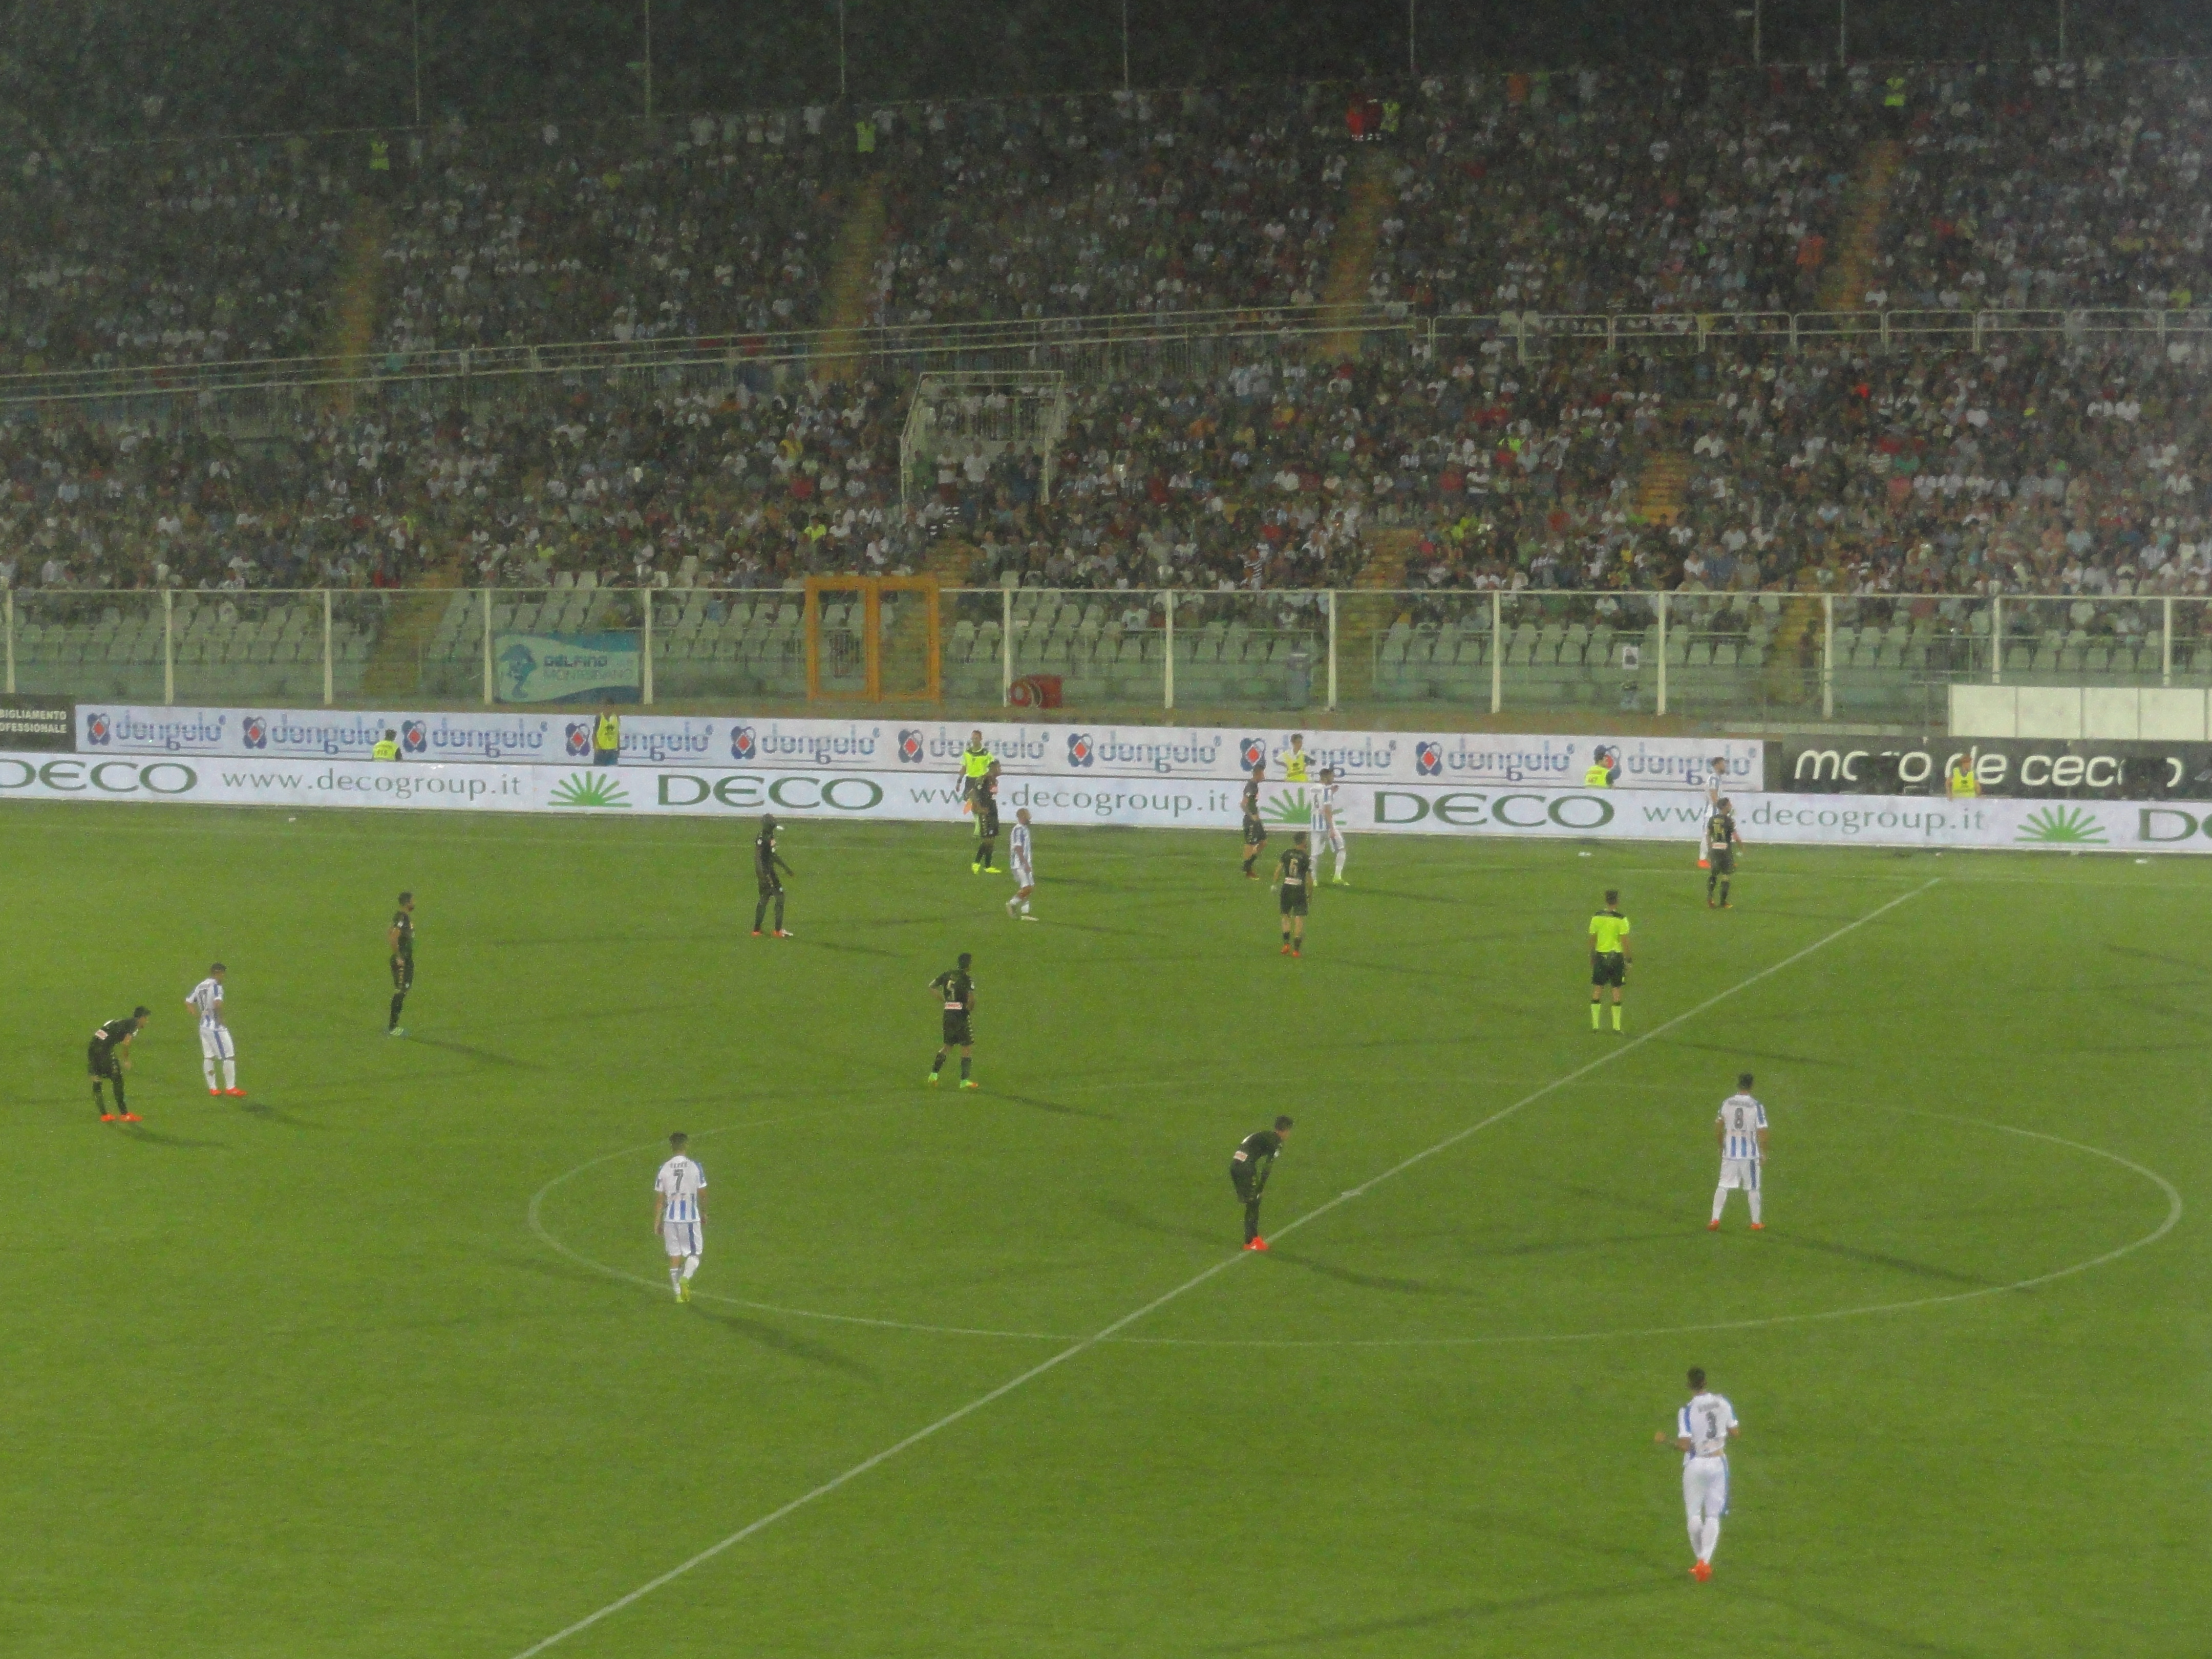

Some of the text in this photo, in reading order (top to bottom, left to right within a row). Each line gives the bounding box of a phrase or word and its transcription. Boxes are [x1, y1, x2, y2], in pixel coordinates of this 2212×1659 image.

[222, 768, 521, 800] www.decogroup.it
[657, 774, 884, 810] DECO
[910, 783, 1229, 817] ww.decogroup.it
[1374, 791, 1615, 830] DECO
[1643, 801, 1985, 836] ww.decogroup.it
[1734, 1107, 1743, 1129] 8
[673, 1169, 683, 1192] 7
